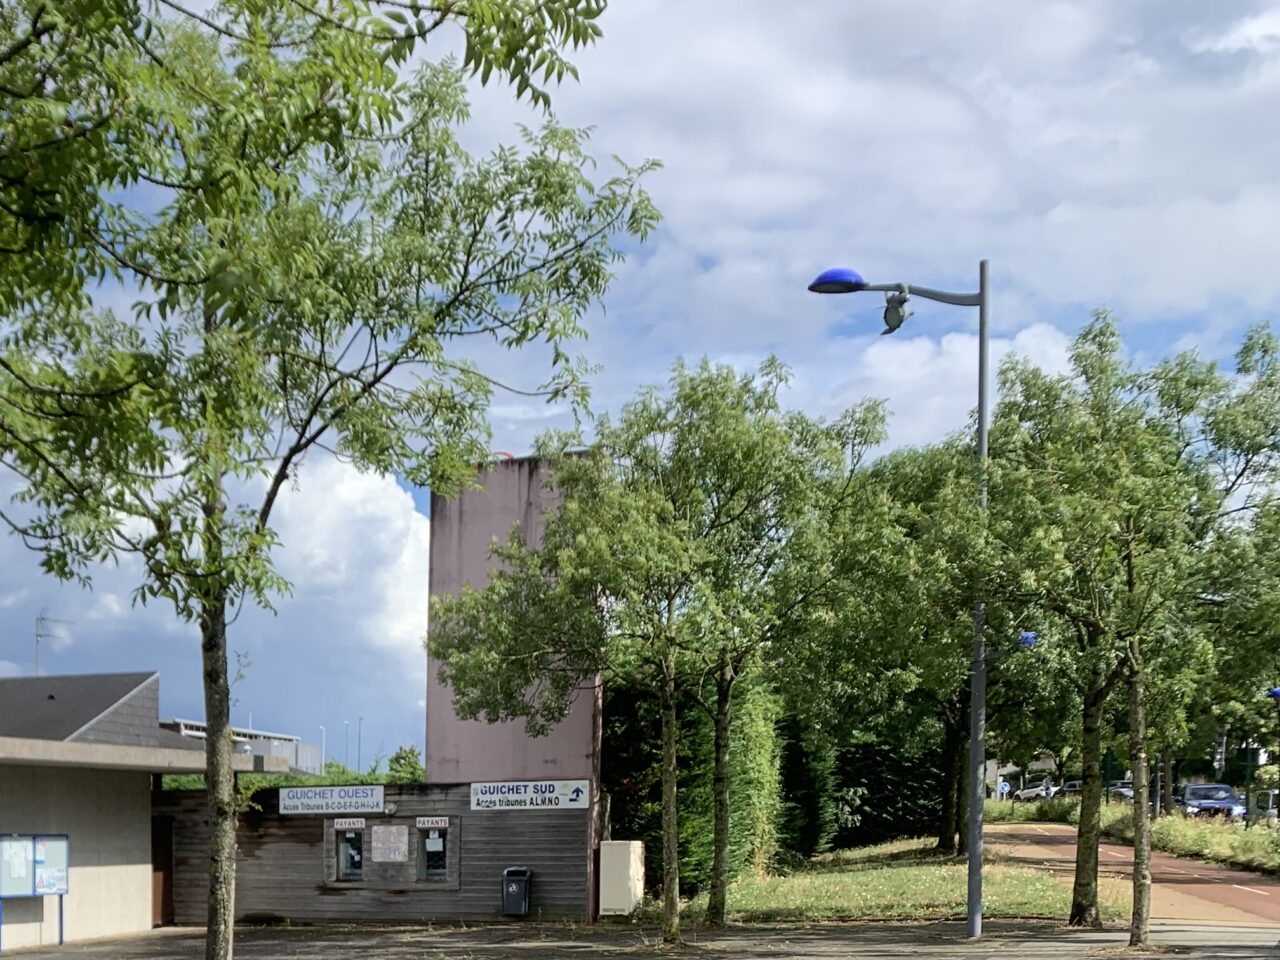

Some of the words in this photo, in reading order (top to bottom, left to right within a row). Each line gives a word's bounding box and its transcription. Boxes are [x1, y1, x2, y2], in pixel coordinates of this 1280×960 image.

[287, 789, 334, 800] GUICHET
[338, 788, 375, 799] OUEST
[480, 784, 529, 795] GUICHET
[533, 783, 556, 794] SUD
